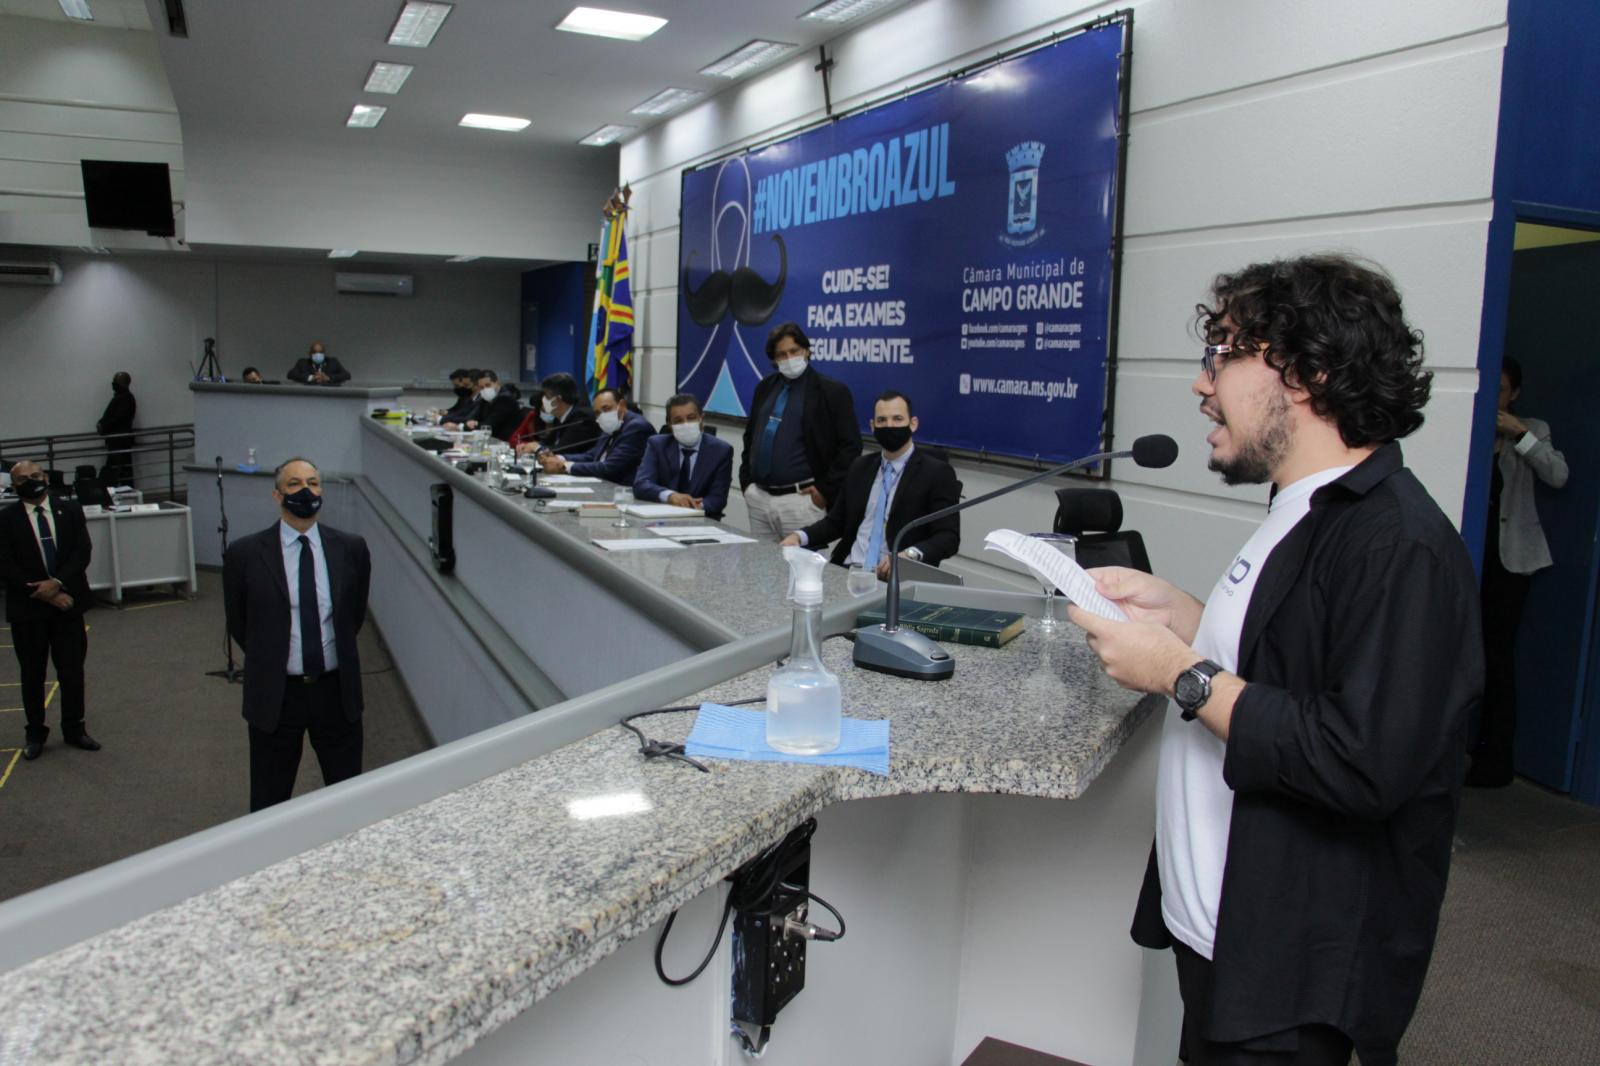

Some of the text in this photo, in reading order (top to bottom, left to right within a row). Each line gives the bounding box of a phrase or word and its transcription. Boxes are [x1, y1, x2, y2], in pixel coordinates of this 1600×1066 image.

[753, 122, 956, 234] #NOVEMBROAZUL
[822, 264, 890, 294] CUIDE-SE!
[963, 257, 1085, 284] Câmara Municipal de
[962, 281, 1084, 312] CAMPO GRANDE
[807, 300, 906, 332] FAÇA EXAMES
[808, 338, 914, 364] EGULARMENTE.
[972, 377, 1078, 402] www.camara.ms.gov.br
